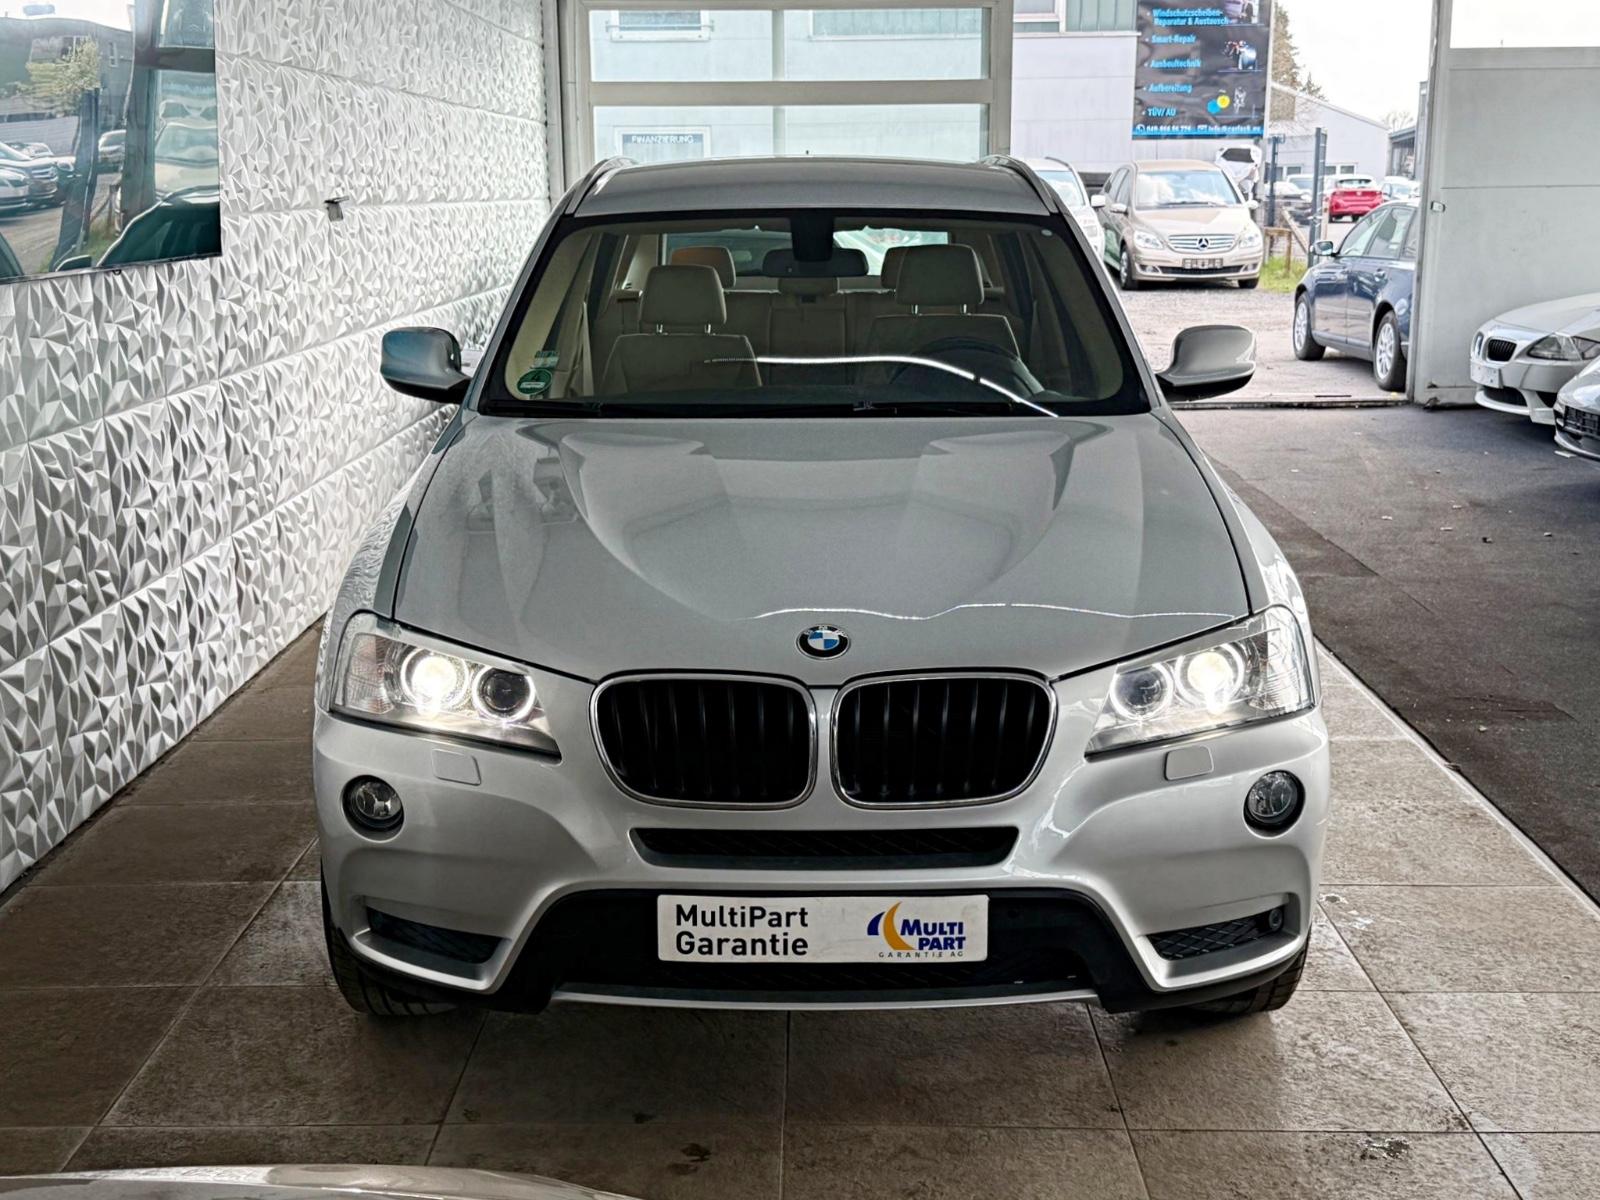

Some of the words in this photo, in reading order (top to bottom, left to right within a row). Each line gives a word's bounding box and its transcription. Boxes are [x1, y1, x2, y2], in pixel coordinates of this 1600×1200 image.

[675, 904, 809, 928] MultiPart
[901, 919, 964, 936] MULTI
[675, 931, 809, 956] Garantie
[918, 937, 966, 951] PART
